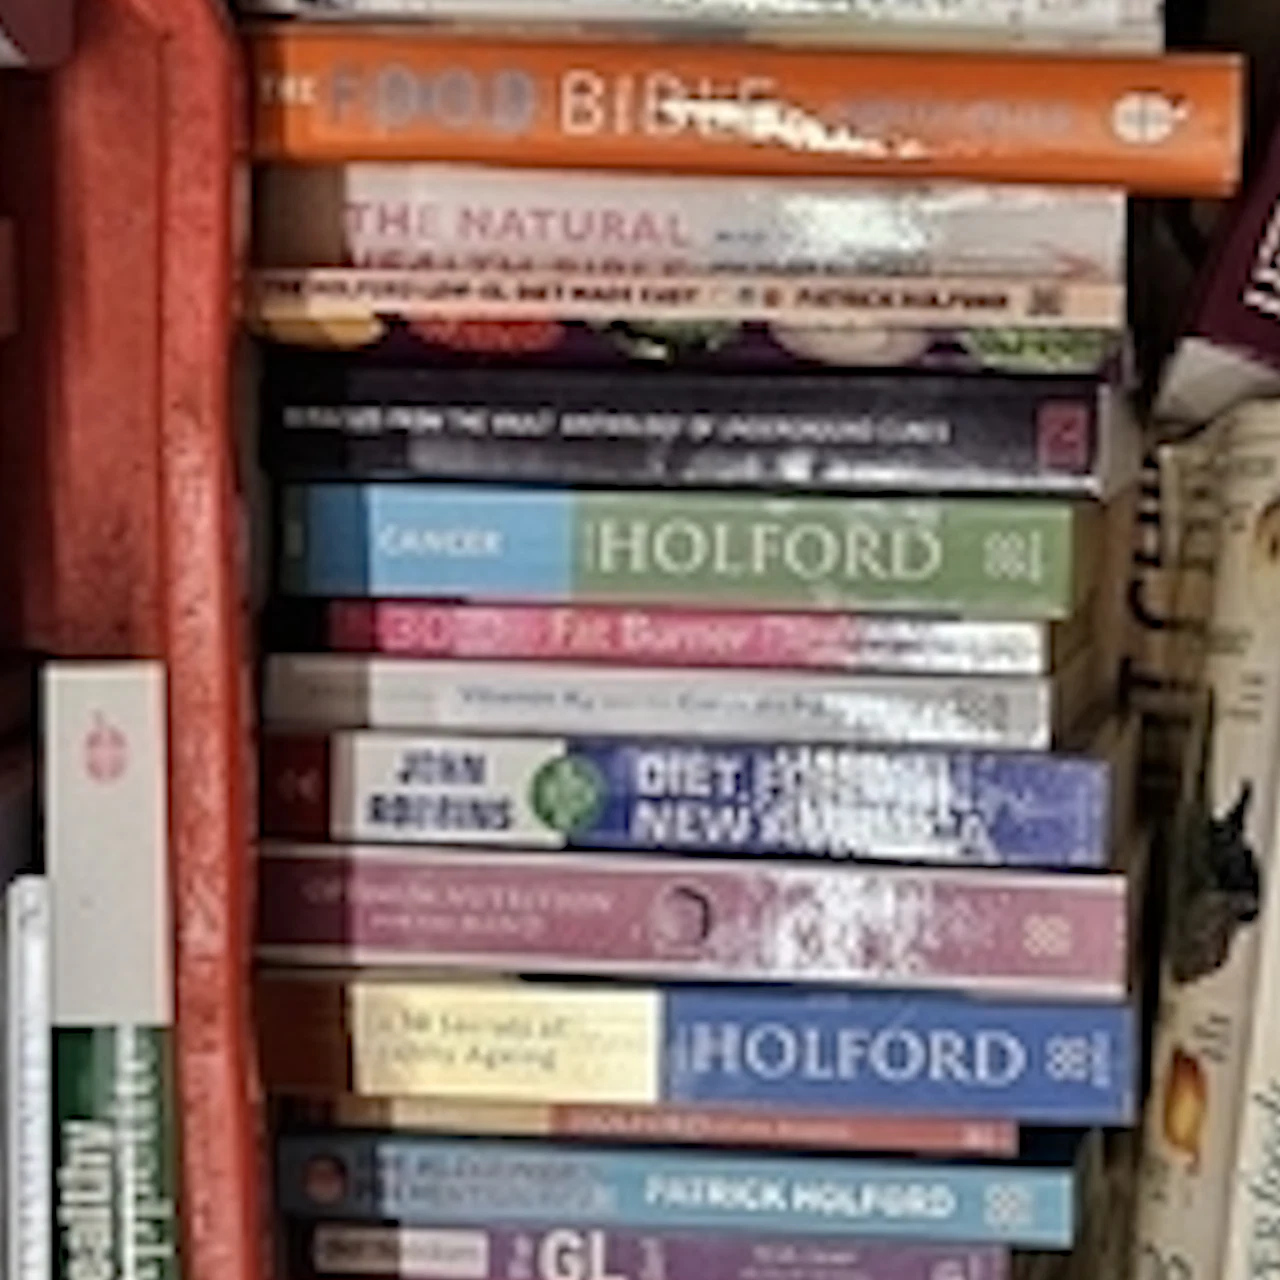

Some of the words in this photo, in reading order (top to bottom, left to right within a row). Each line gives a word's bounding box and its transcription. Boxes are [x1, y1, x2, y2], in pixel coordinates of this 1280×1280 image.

[261, 77, 317, 107] THE
[330, 67, 538, 129] FOOD
[351, 200, 443, 240] THE
[457, 204, 691, 250] NATURAL
[379, 529, 504, 558] CANCER
[597, 517, 943, 582] HOLFORD
[635, 749, 740, 800] DIET
[692, 1022, 1027, 1087] HOLFORD
[642, 1174, 789, 1212] PATRICK
[793, 1183, 958, 1219] HOLFORD
